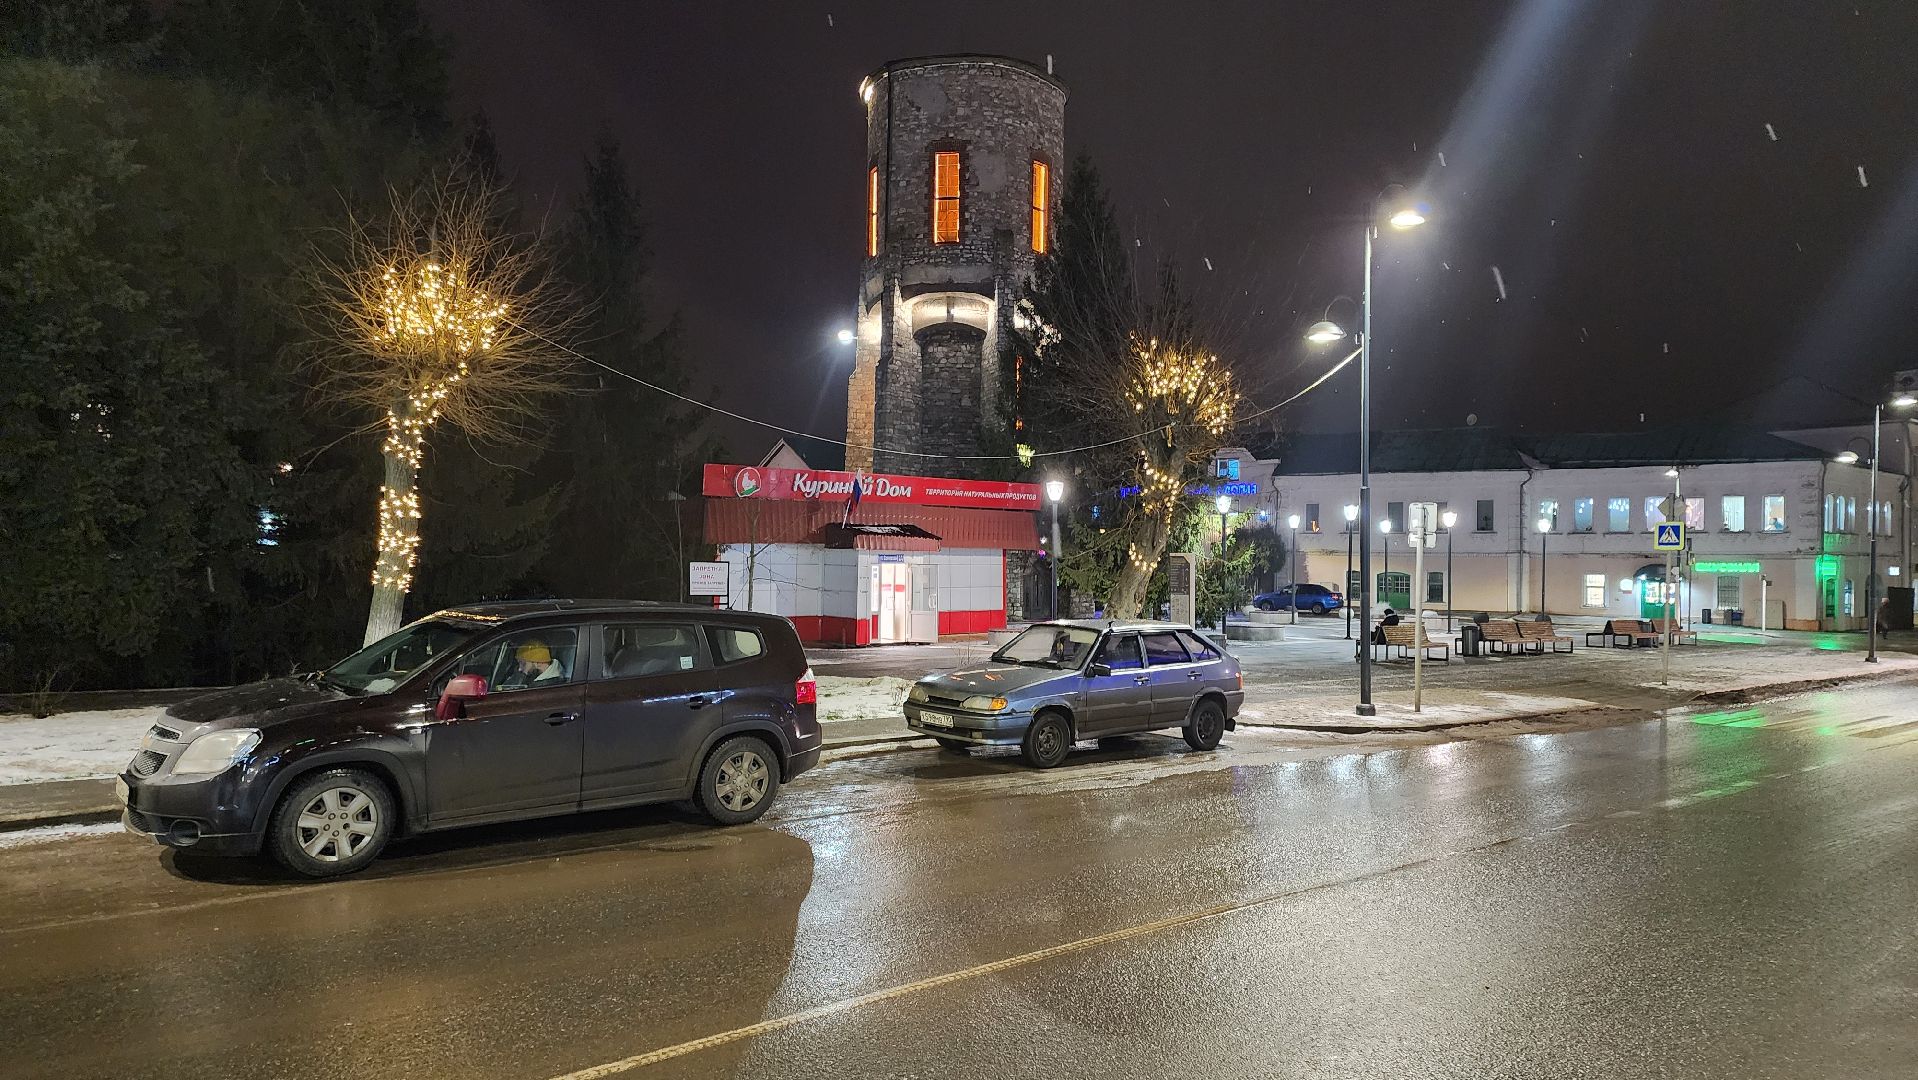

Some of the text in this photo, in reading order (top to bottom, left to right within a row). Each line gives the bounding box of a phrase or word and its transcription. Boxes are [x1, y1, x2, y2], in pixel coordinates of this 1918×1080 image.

[876, 478, 912, 497] Дом
[925, 488, 1037, 501] ТЕРРИТОРИЯ НАТУРАЛЬНЫХ ПРОДУКТОВ
